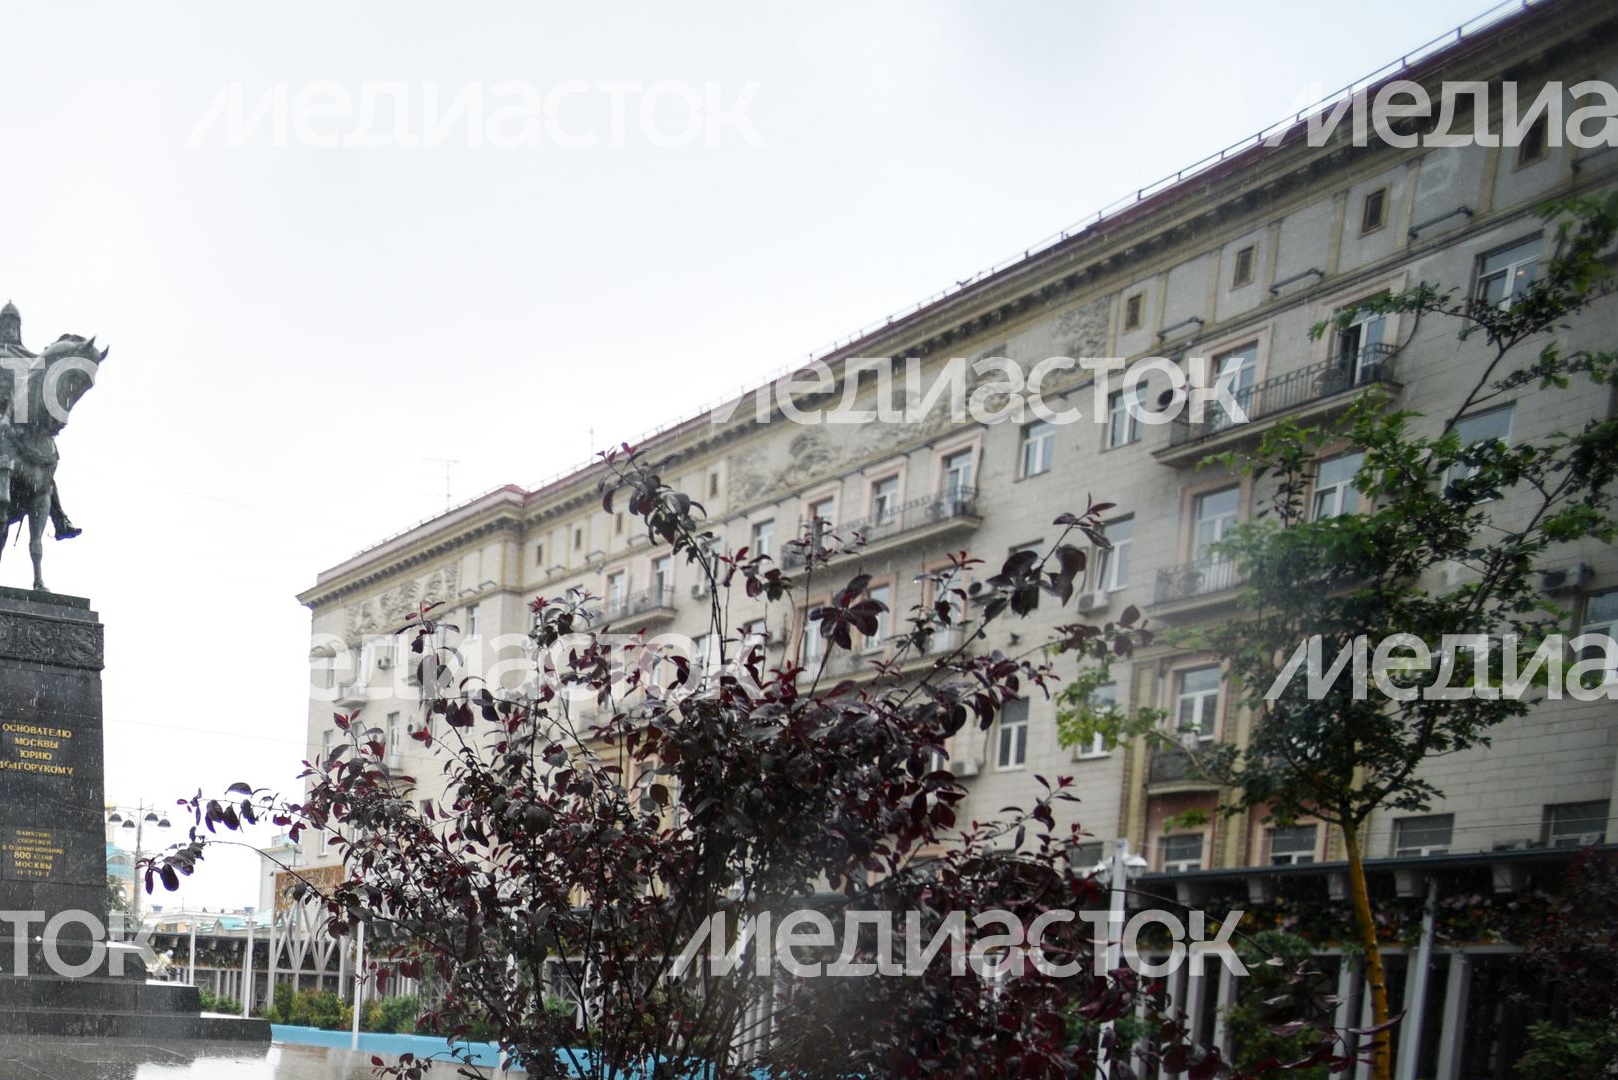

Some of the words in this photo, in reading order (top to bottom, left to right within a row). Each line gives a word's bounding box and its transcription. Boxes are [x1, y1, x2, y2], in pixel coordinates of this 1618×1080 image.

[2, 723, 72, 738] ОСНОВАТЕЛЮ
[14, 737, 59, 749] МОСКВЫ
[19, 750, 52, 761] ЮРИЮ
[13, 851, 31, 859] 800
[14, 860, 53, 870] МОСКВЫ
